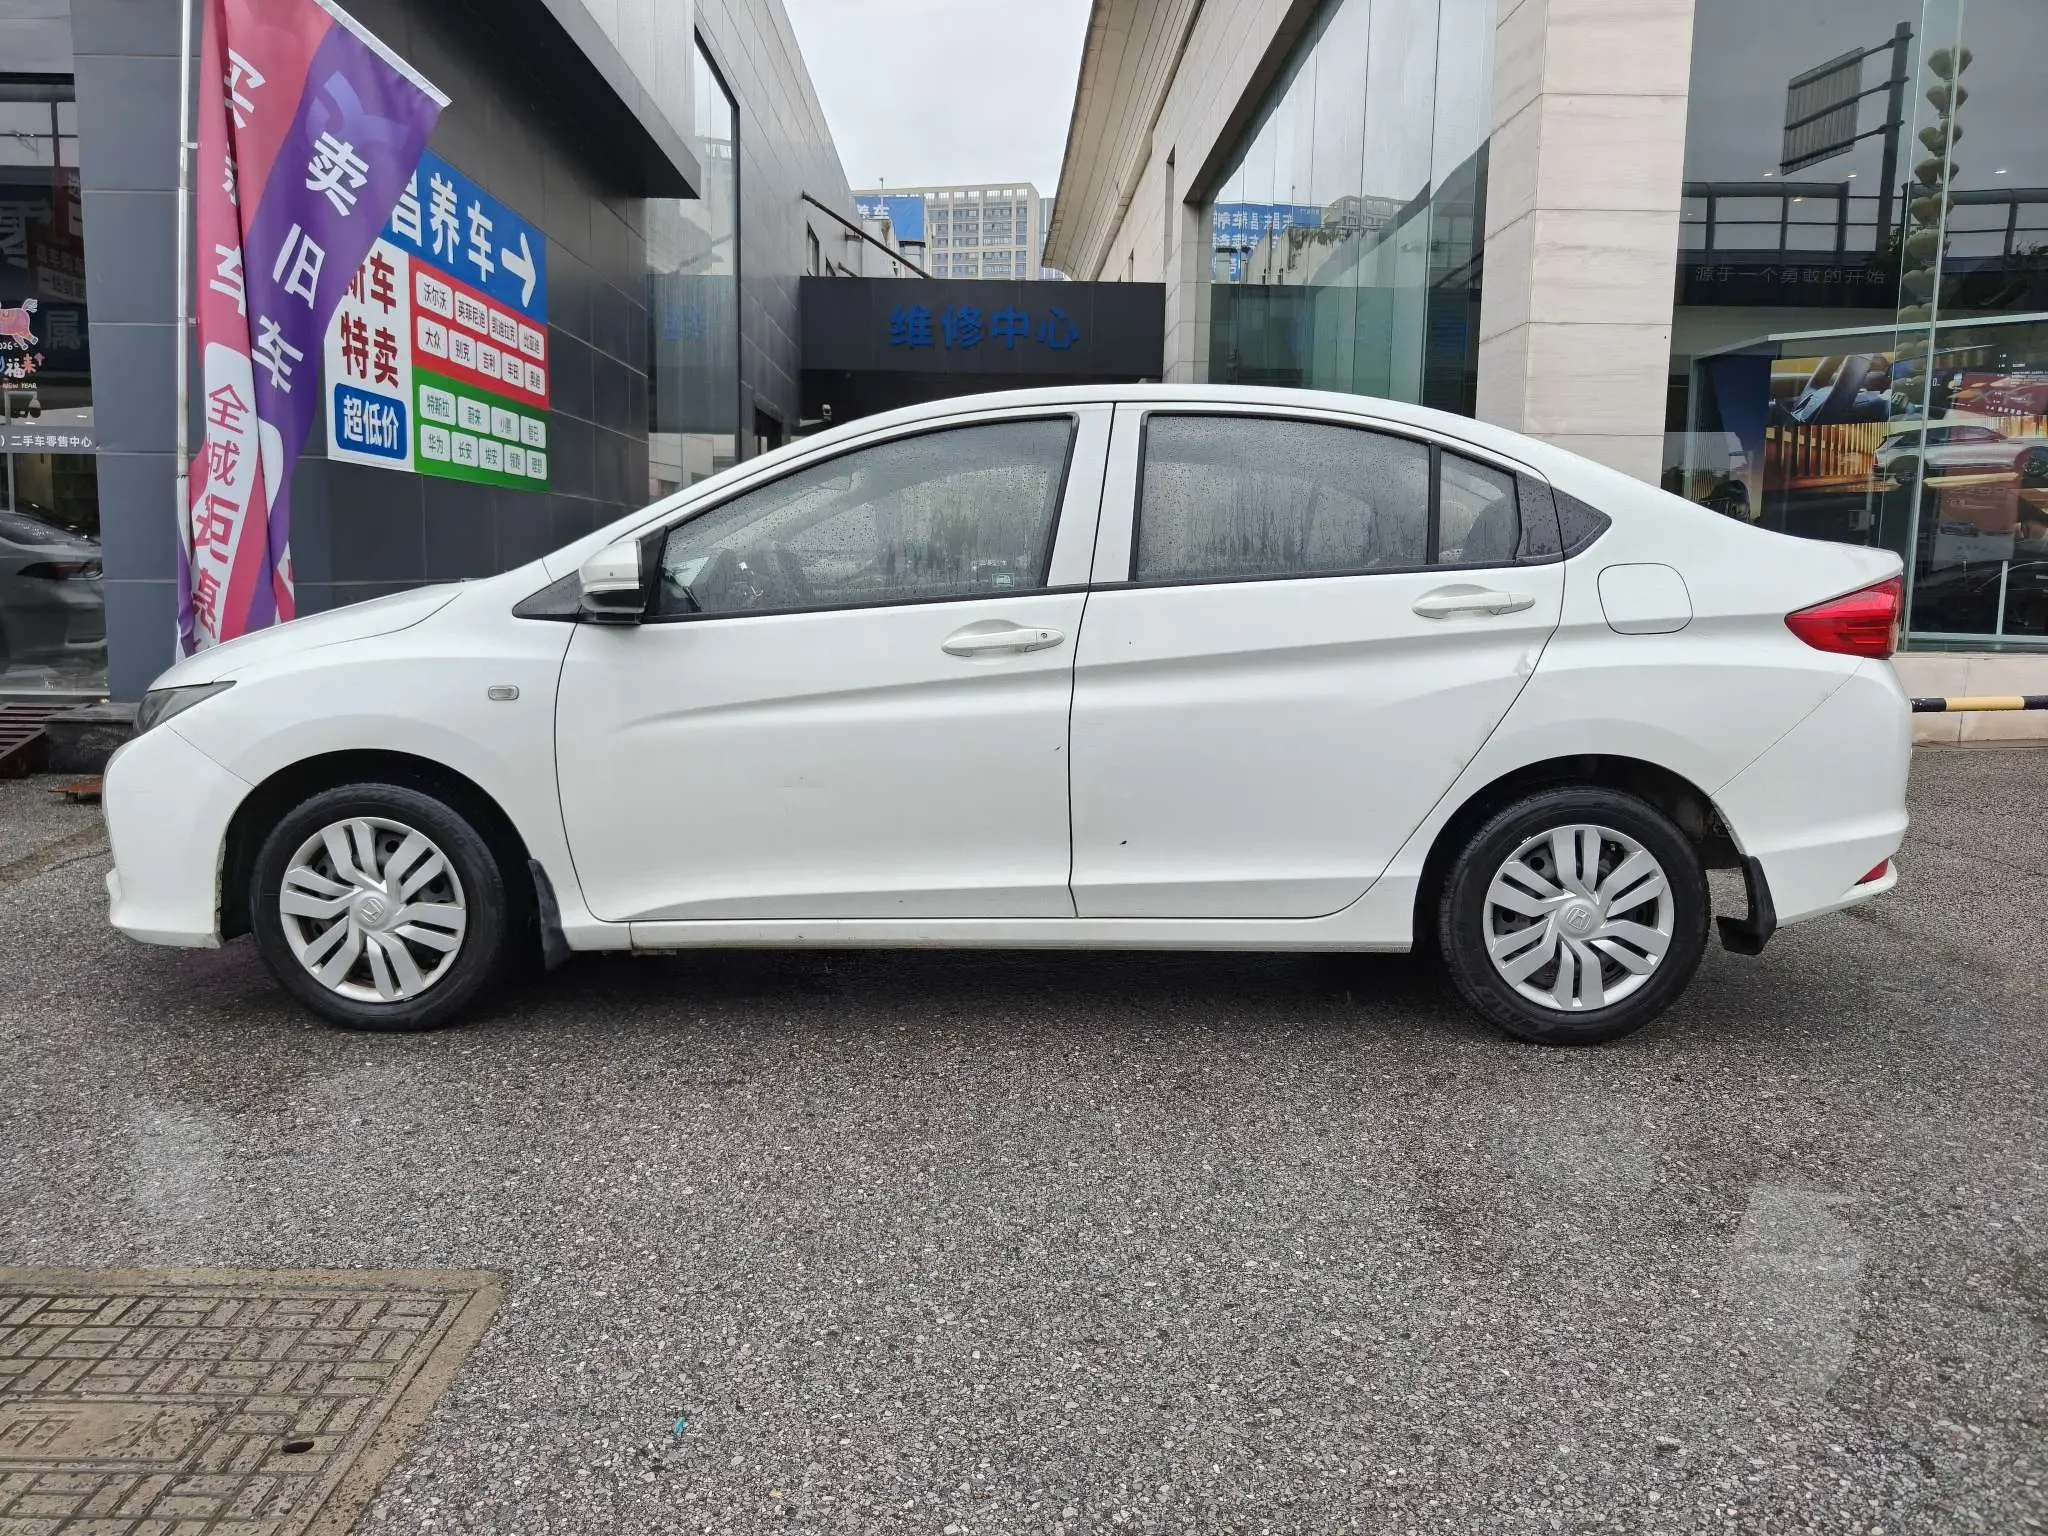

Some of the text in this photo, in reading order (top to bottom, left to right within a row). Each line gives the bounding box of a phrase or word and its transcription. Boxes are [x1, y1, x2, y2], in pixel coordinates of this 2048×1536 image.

[251, 130, 371, 394] 卖旧车
[1695, 264, 1889, 285] 源于一个勇敢的开始
[424, 282, 447, 310] 沃尔沃
[458, 300, 486, 328] 英菲尼迪
[889, 304, 1080, 351] 维修中心
[0, 353, 37, 379] 福来
[340, 311, 399, 388] 特卖
[425, 327, 440, 349] 大众
[455, 339, 470, 361] 别克
[343, 394, 399, 451] 超低价
[428, 432, 444, 455] 华为
[459, 440, 473, 460] 长安
